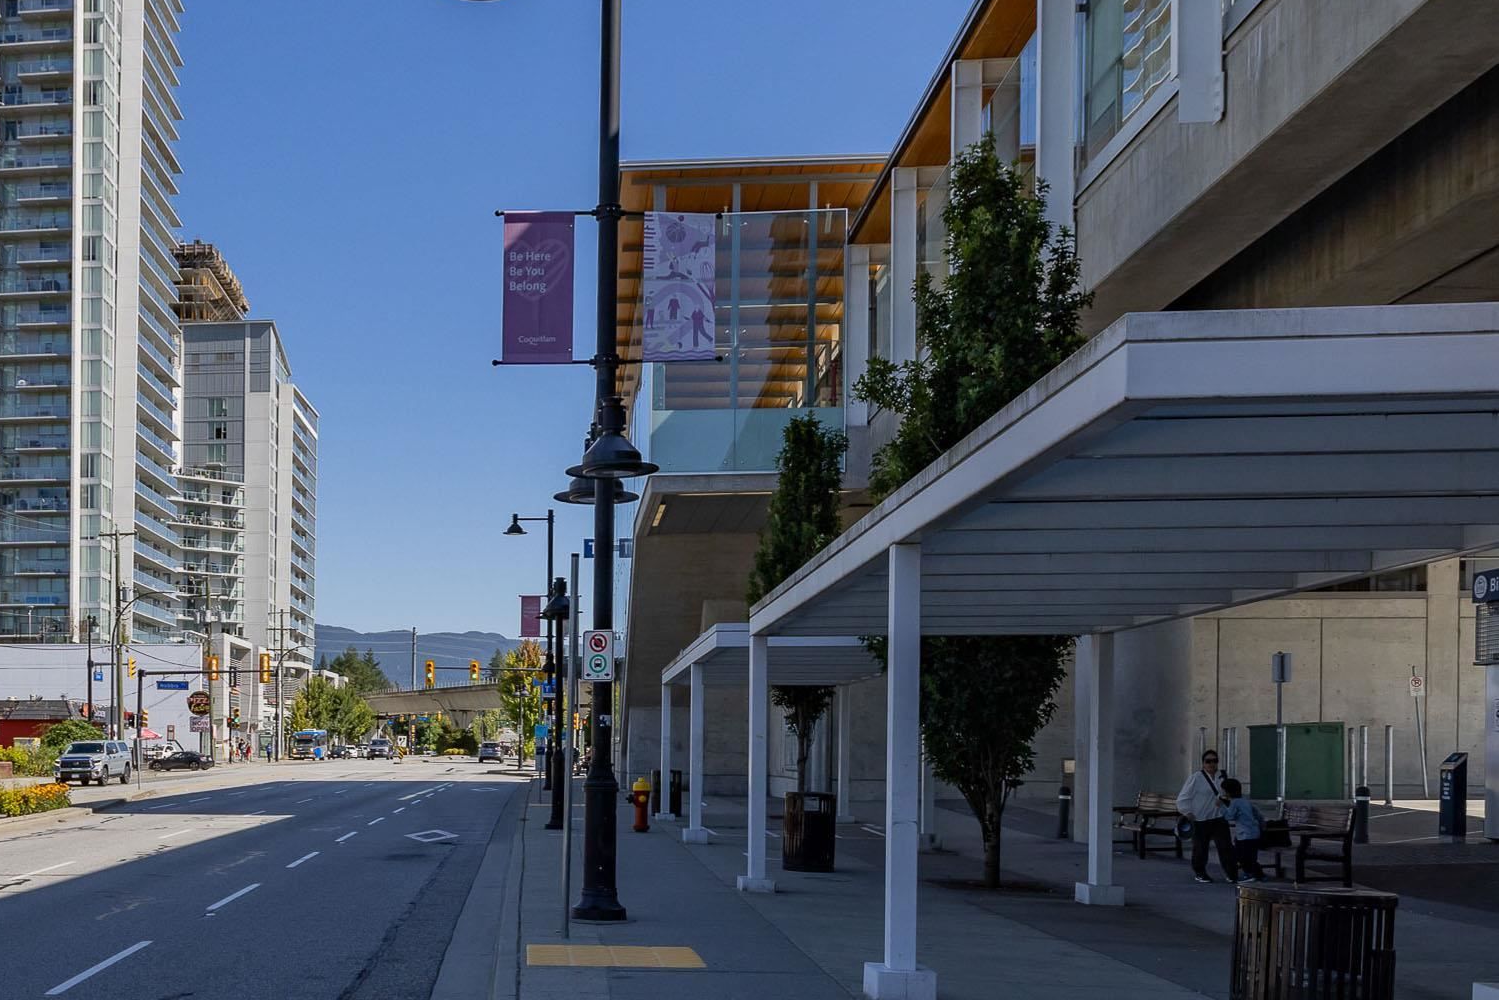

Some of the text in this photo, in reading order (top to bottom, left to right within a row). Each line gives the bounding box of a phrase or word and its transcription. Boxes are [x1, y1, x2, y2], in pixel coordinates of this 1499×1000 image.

[509, 252, 551, 261] Be Here
[509, 266, 545, 276] Be You
[509, 281, 547, 293] Belong
[518, 336, 556, 345] Coquitlam
[1490, 577, 1499, 592] Bi
